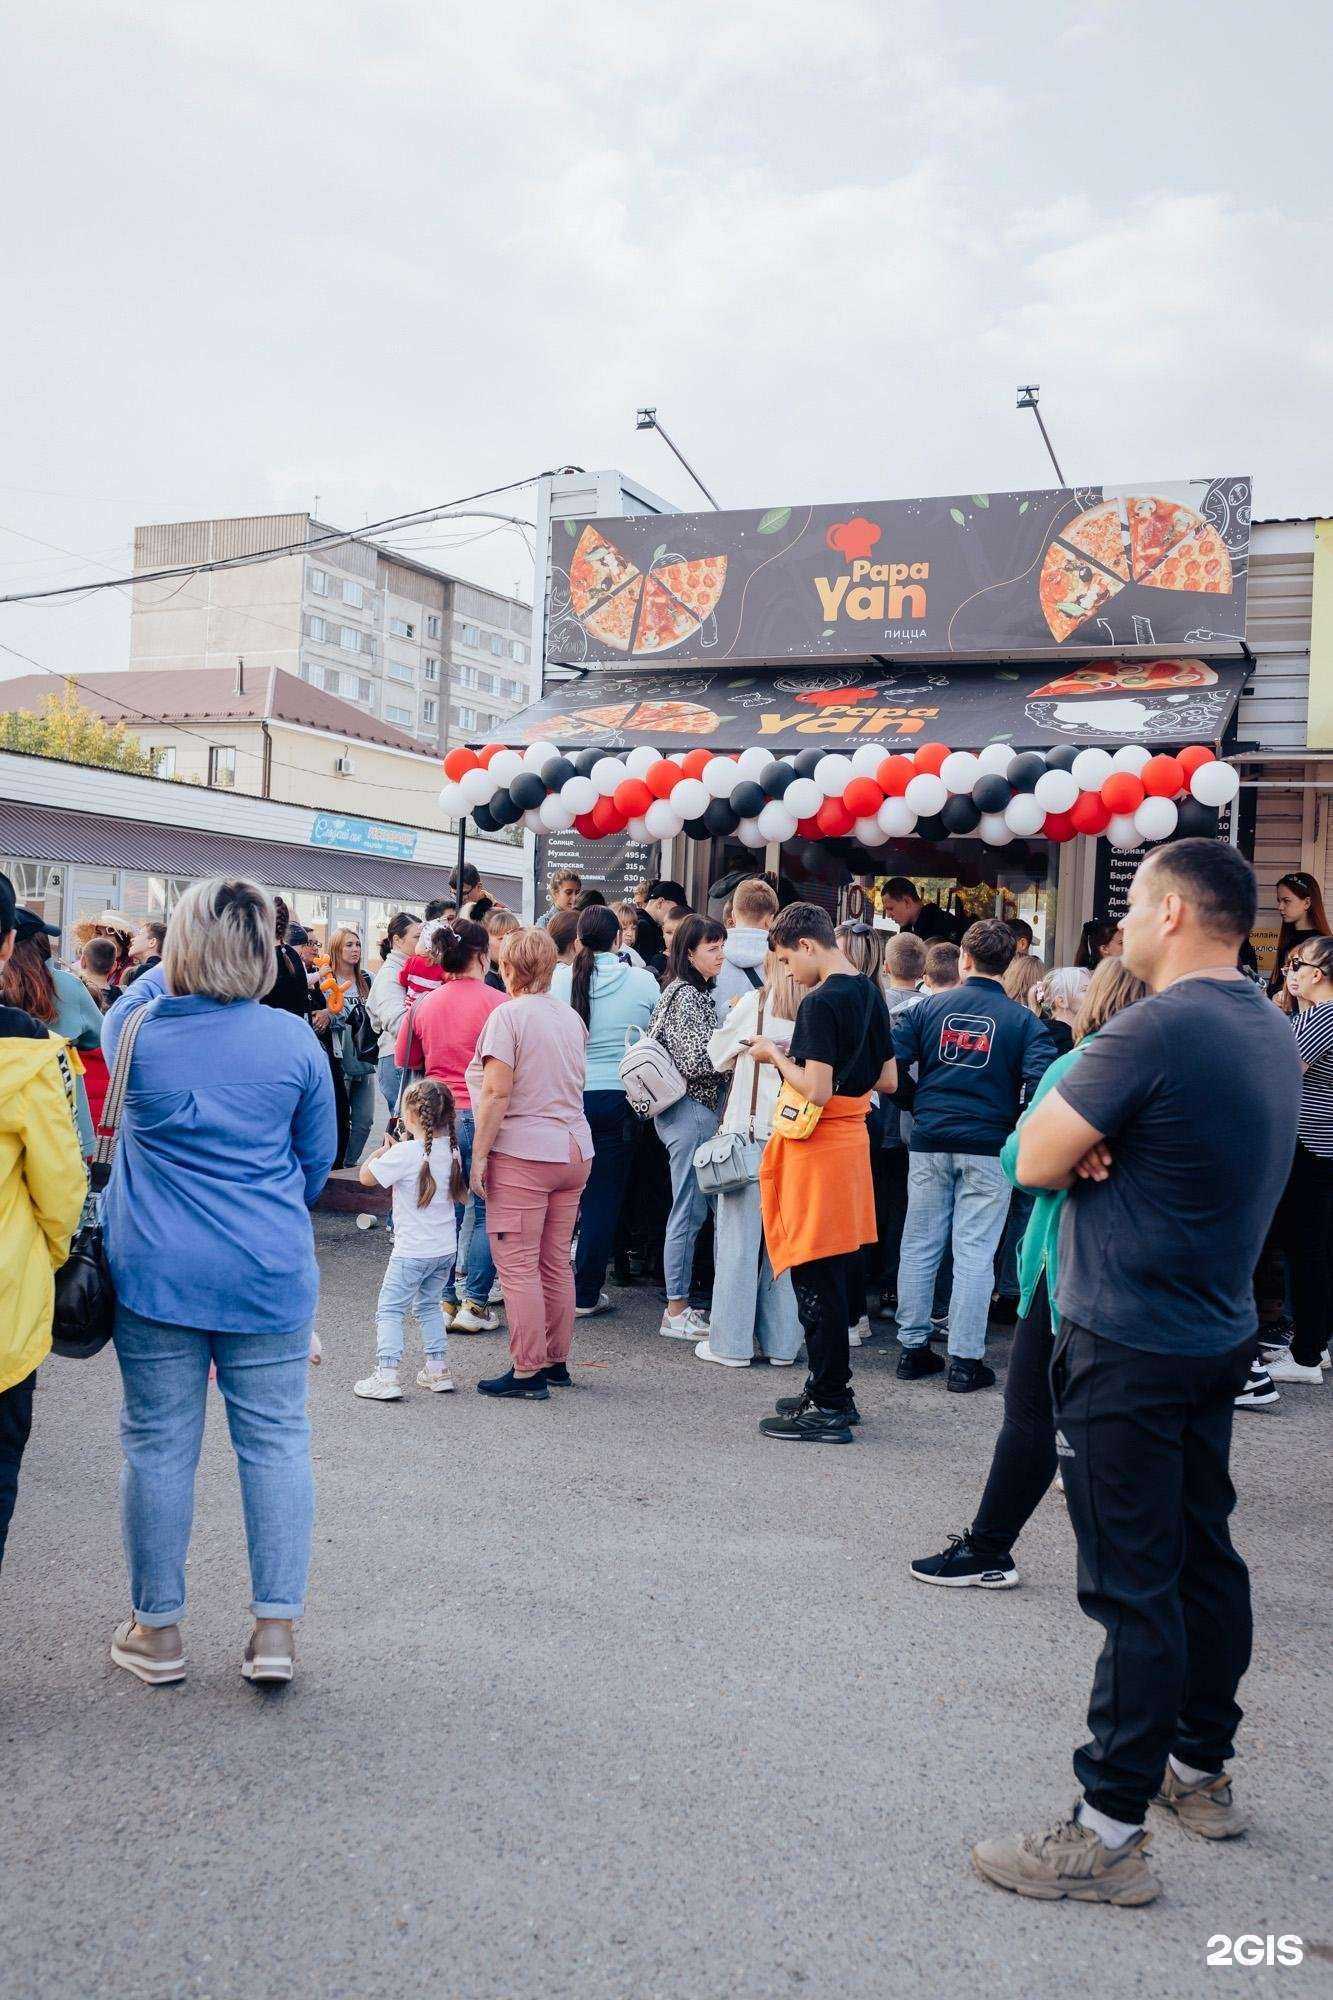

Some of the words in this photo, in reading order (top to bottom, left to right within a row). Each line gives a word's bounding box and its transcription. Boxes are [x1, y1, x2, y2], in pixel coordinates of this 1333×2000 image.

[853, 560, 929, 586] Papa
[814, 576, 927, 622] Yan
[884, 629, 928, 639] ПИЦЦА
[819, 705, 941, 719] Papa
[757, 713, 925, 734] Yan
[547, 849, 580, 858] Мужская
[625, 851, 639, 859] 495
[1110, 859, 1142, 867] Пеппер
[1107, 909, 1127, 918] Тоск
